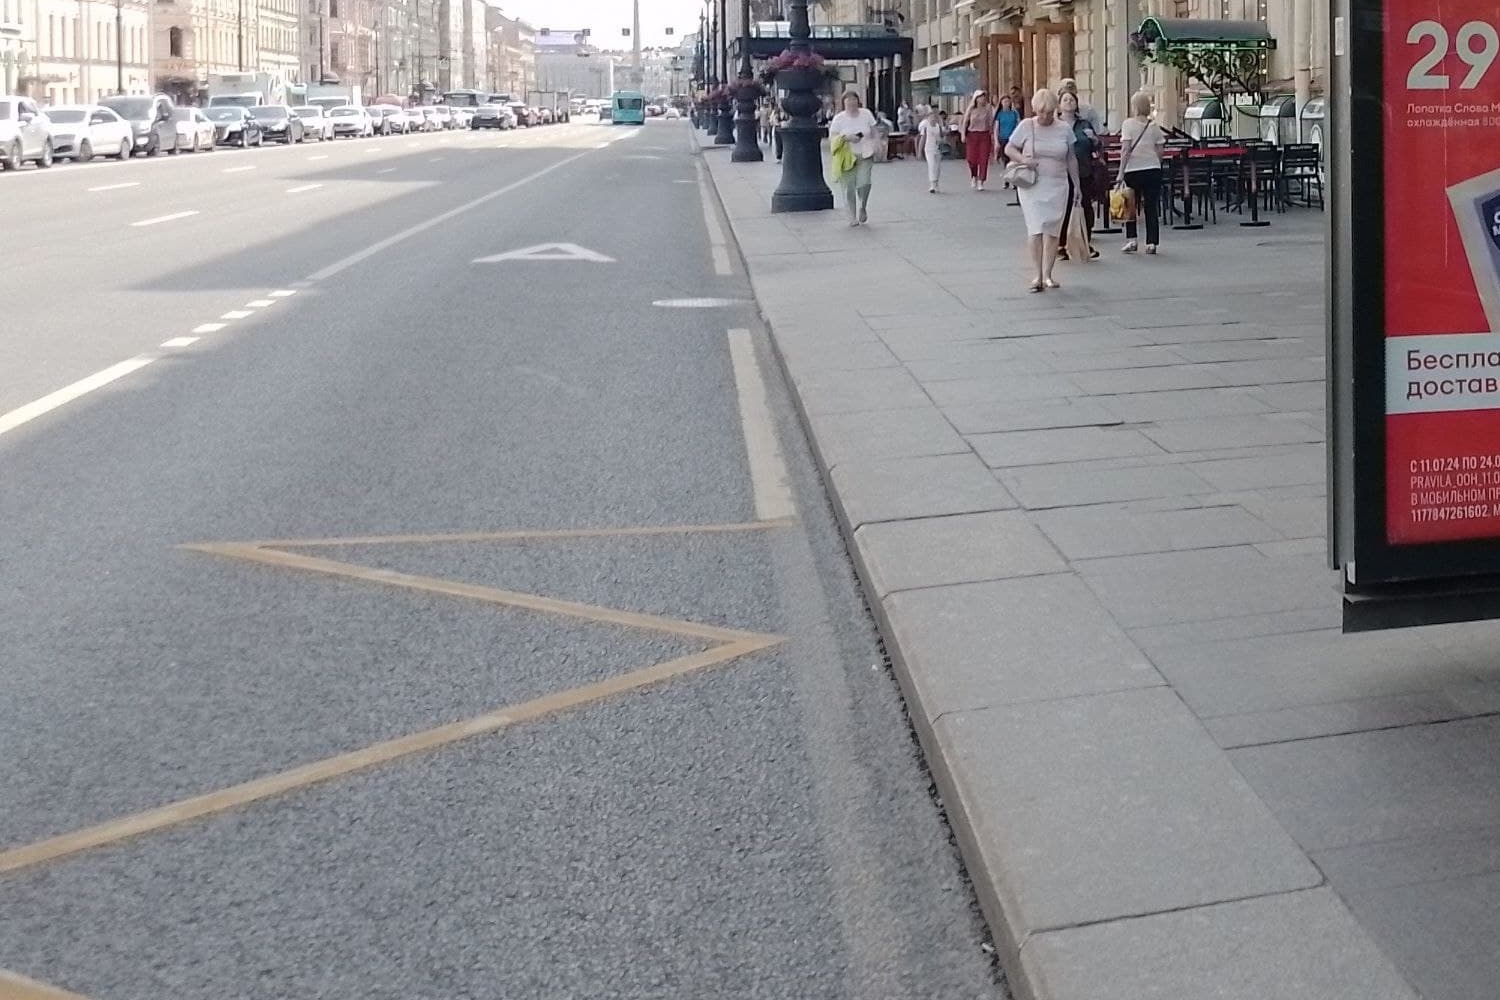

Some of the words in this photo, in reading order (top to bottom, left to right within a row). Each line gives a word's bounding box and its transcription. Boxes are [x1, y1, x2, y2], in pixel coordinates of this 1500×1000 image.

[1406, 103, 1452, 114] Лопатка
[1410, 460, 1417, 473] С
[1420, 457, 1460, 473] 11.07.24
[1462, 456, 1477, 470] ПО
[1410, 492, 1418, 506] В
[1420, 488, 1486, 505] МОБИЛЬНОМ
